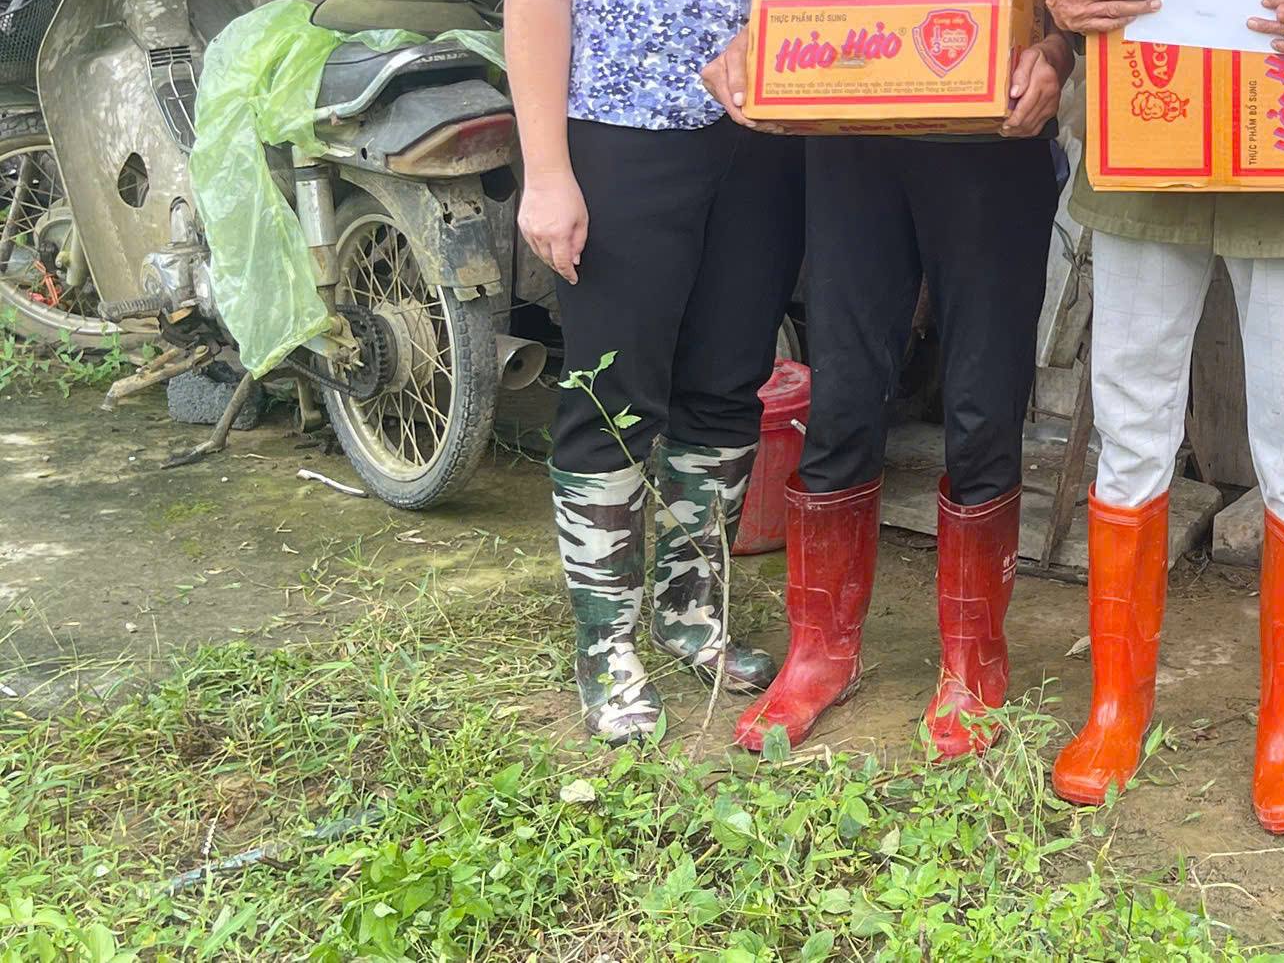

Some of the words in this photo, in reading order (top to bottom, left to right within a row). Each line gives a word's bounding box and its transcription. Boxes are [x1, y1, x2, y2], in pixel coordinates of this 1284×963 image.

[827, 14, 847, 22] SUNG
[774, 30, 838, 73] Hảo
[841, 21, 902, 61] Hảo
[1122, 49, 1144, 88] Cook
[1248, 80, 1257, 102] SUNG
[1248, 144, 1258, 165] THỰC
